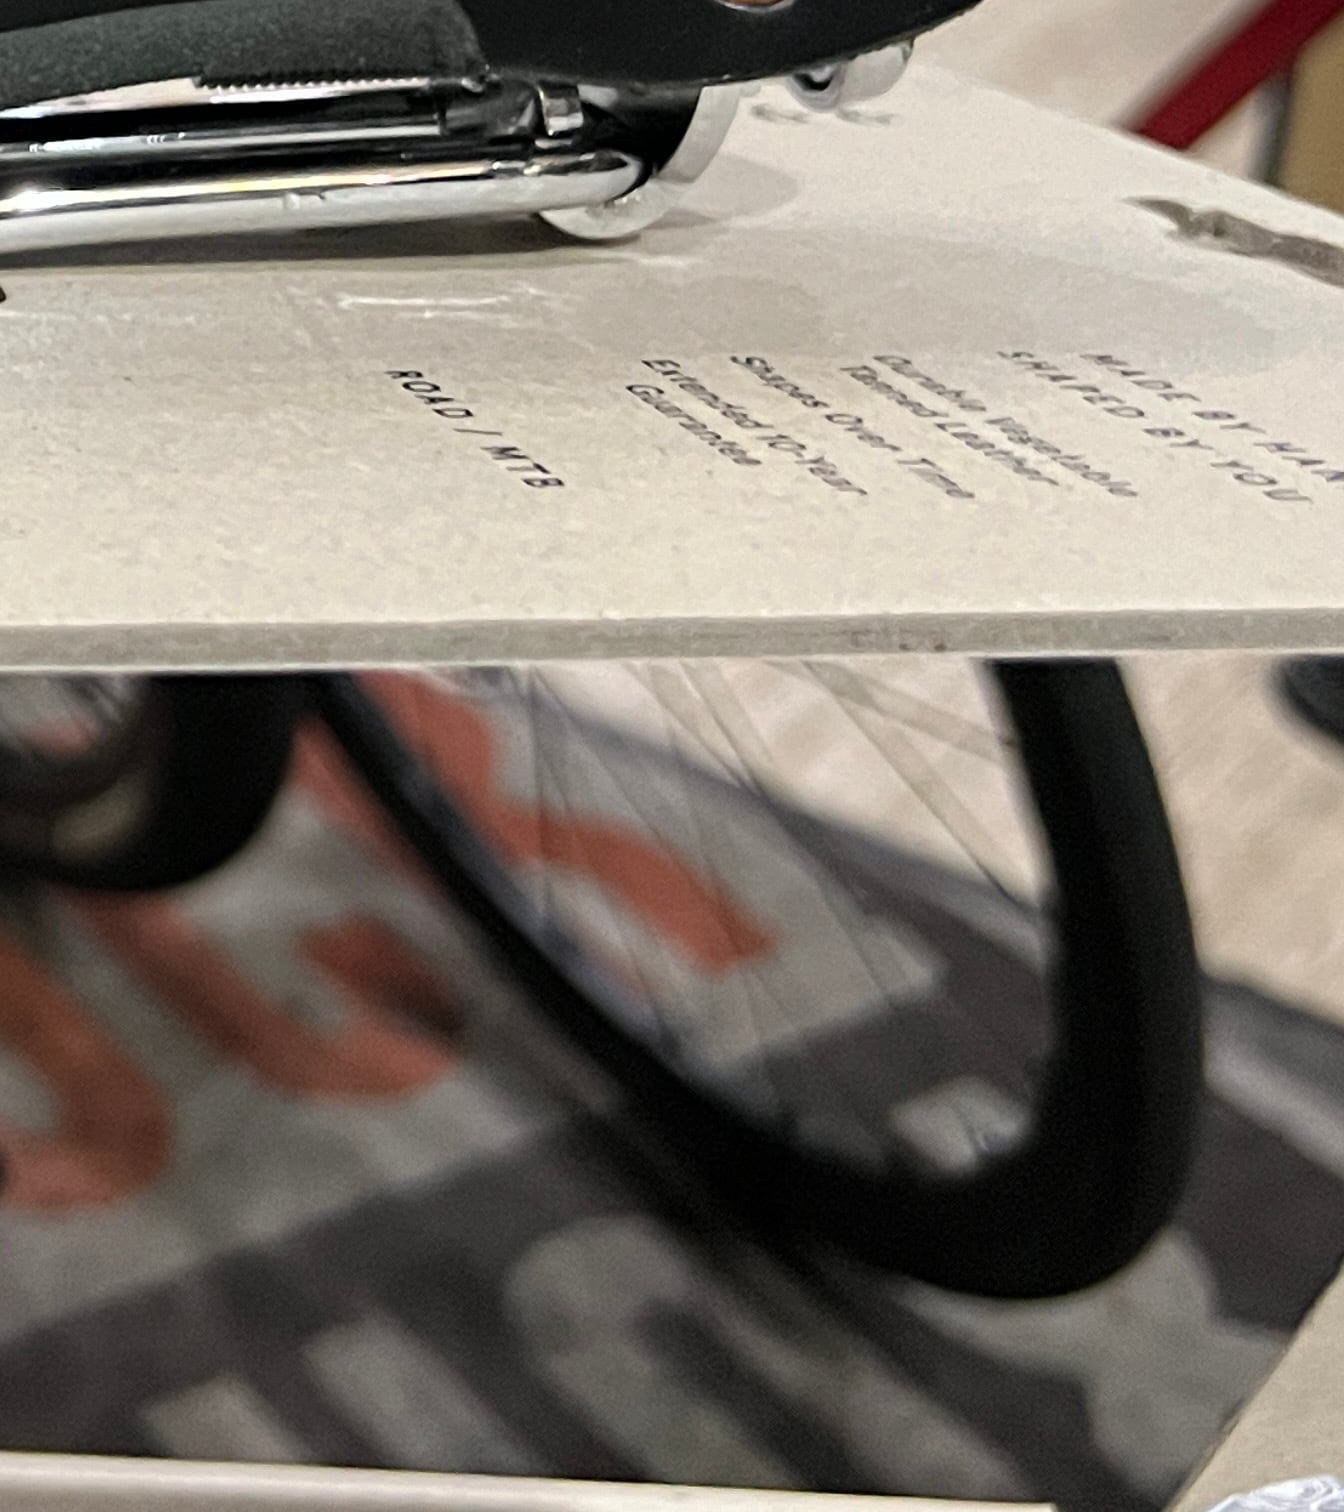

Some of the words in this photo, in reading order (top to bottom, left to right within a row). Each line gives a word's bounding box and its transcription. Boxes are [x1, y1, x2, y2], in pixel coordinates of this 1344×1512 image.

[384, 370, 474, 418] ROAD
[480, 445, 565, 487] MTB
[626, 384, 762, 466] Guarantee
[641, 358, 775, 429] Extended
[756, 433, 868, 496] 10-Year
[730, 355, 830, 409] Shapes
[825, 412, 902, 452] Over
[896, 457, 975, 499] Time
[997, 350, 1145, 419] SHAPED
[1142, 427, 1214, 450] BY
[1210, 460, 1313, 503] YOU
[1080, 353, 1202, 402] MADE
[1192, 410, 1266, 435] BY
